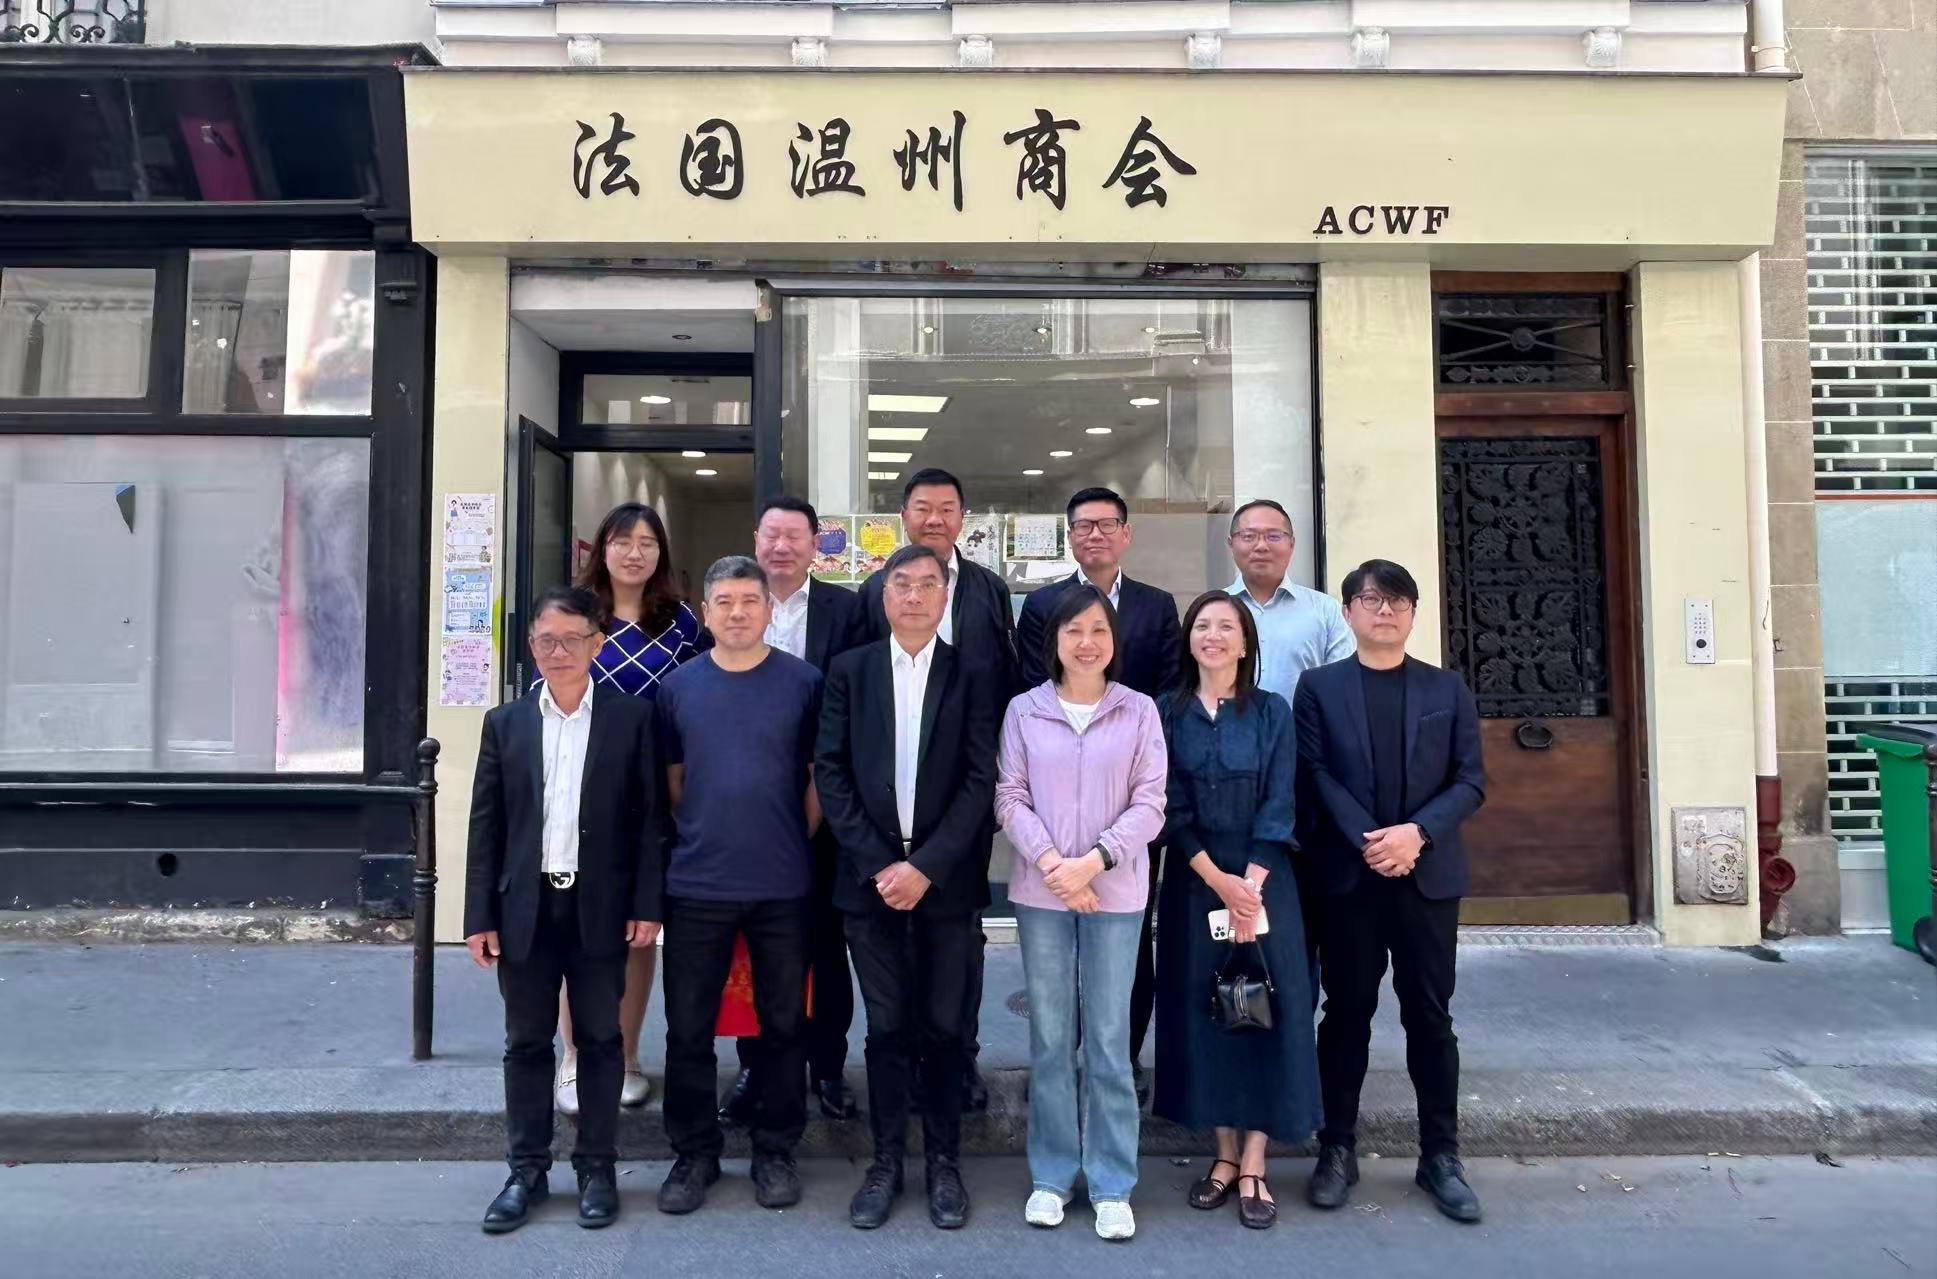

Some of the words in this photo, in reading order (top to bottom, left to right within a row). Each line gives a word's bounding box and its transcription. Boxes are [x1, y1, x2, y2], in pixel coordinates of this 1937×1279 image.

[573, 109, 1197, 212] 法国温州商会
[1313, 205, 1449, 235] ACWF
